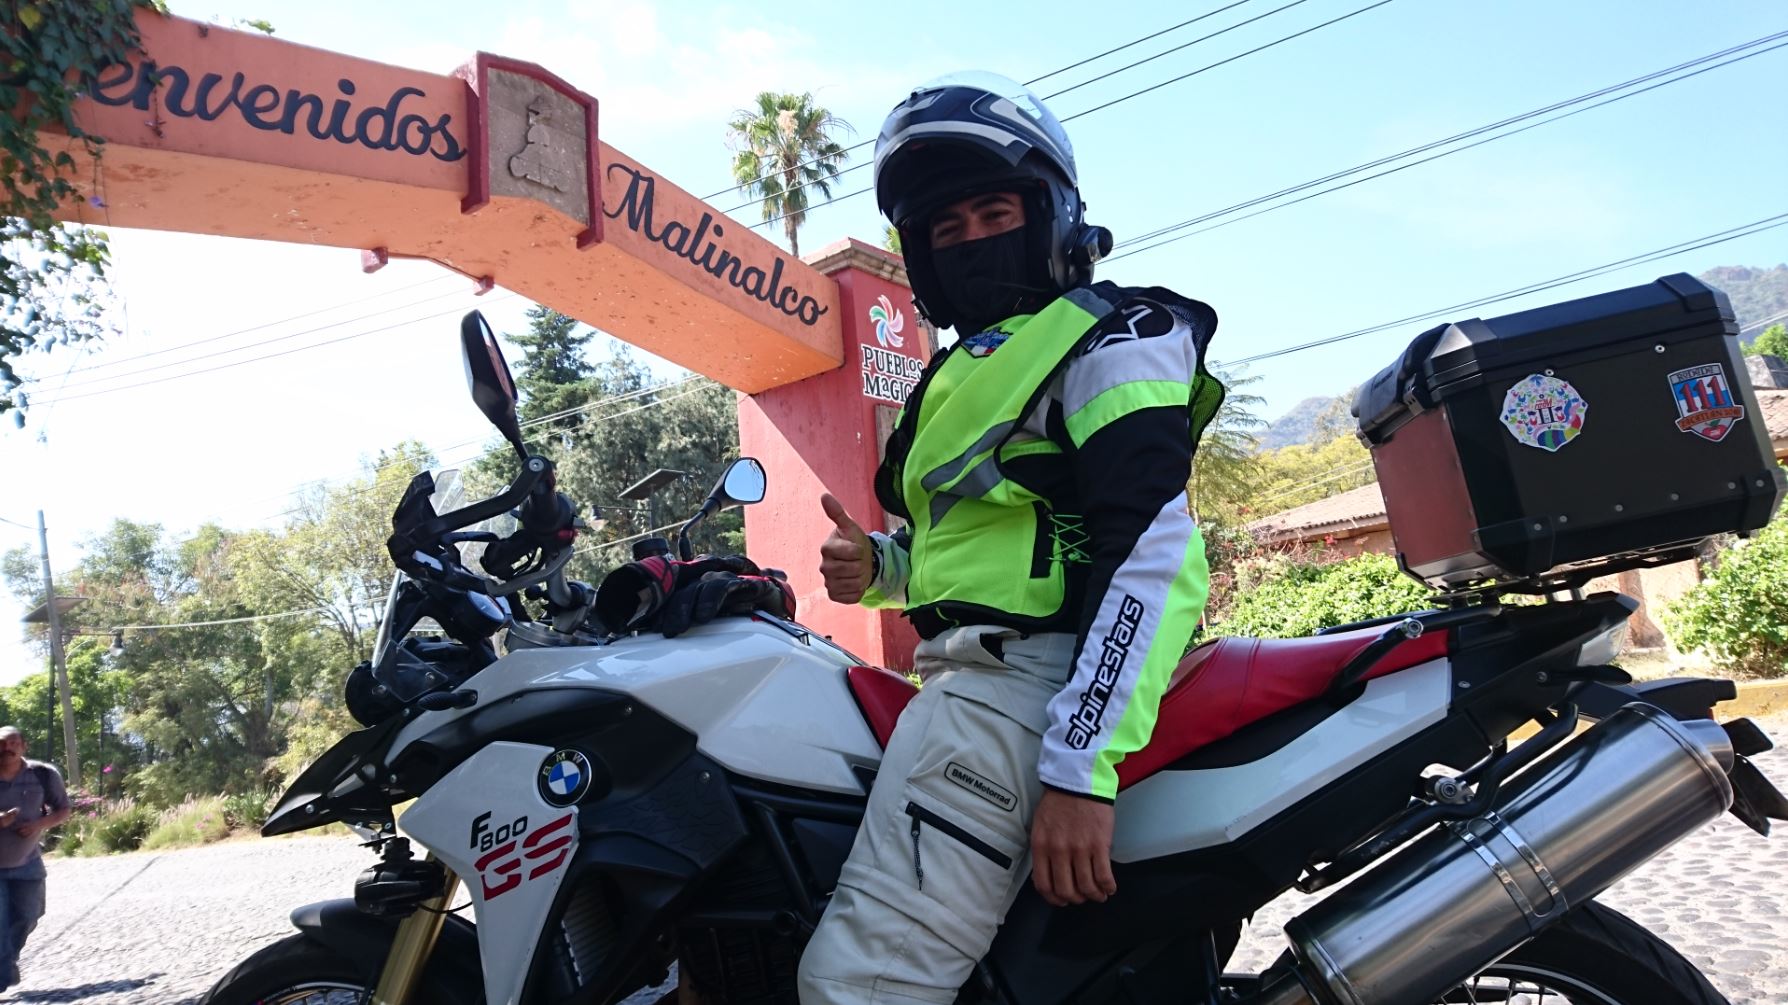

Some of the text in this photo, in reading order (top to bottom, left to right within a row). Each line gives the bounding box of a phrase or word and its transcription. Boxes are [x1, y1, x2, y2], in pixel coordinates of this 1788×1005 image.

[90, 56, 467, 162] envenidos
[602, 163, 828, 326] Malinalco
[1679, 375, 1726, 412] 111
[1066, 595, 1144, 750] alpinestars
[542, 752, 584, 776] BMW
[951, 768, 1012, 806] BMW Motorrad
[474, 813, 573, 901] GS
